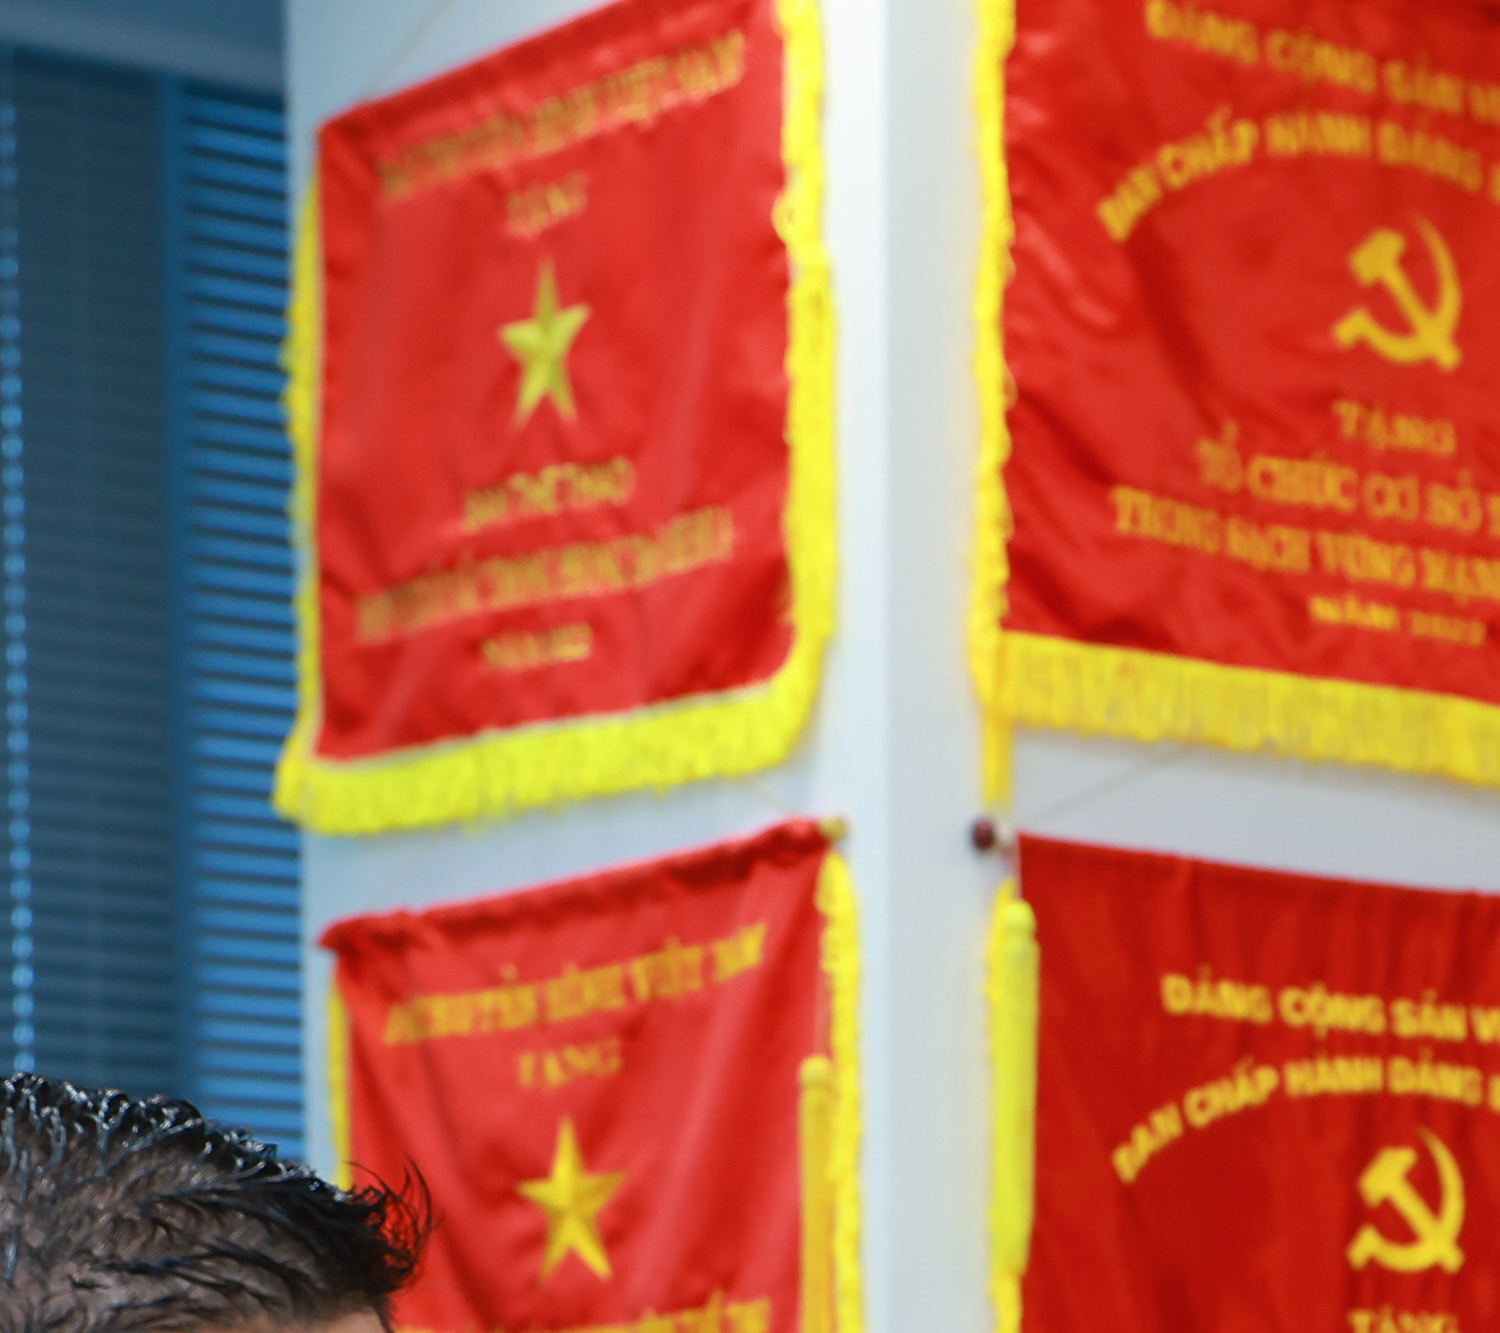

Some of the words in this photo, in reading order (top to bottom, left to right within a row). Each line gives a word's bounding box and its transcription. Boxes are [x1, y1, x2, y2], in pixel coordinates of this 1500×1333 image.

[1161, 967, 1273, 1025] ĐẢNG
[1278, 983, 1386, 1038] CỘNG
[1391, 989, 1467, 1041] SẢN
[1183, 1056, 1279, 1128] CHẤP
[1283, 1051, 1384, 1096] HÀNH
[1387, 1048, 1483, 1106] ĐẢNG
